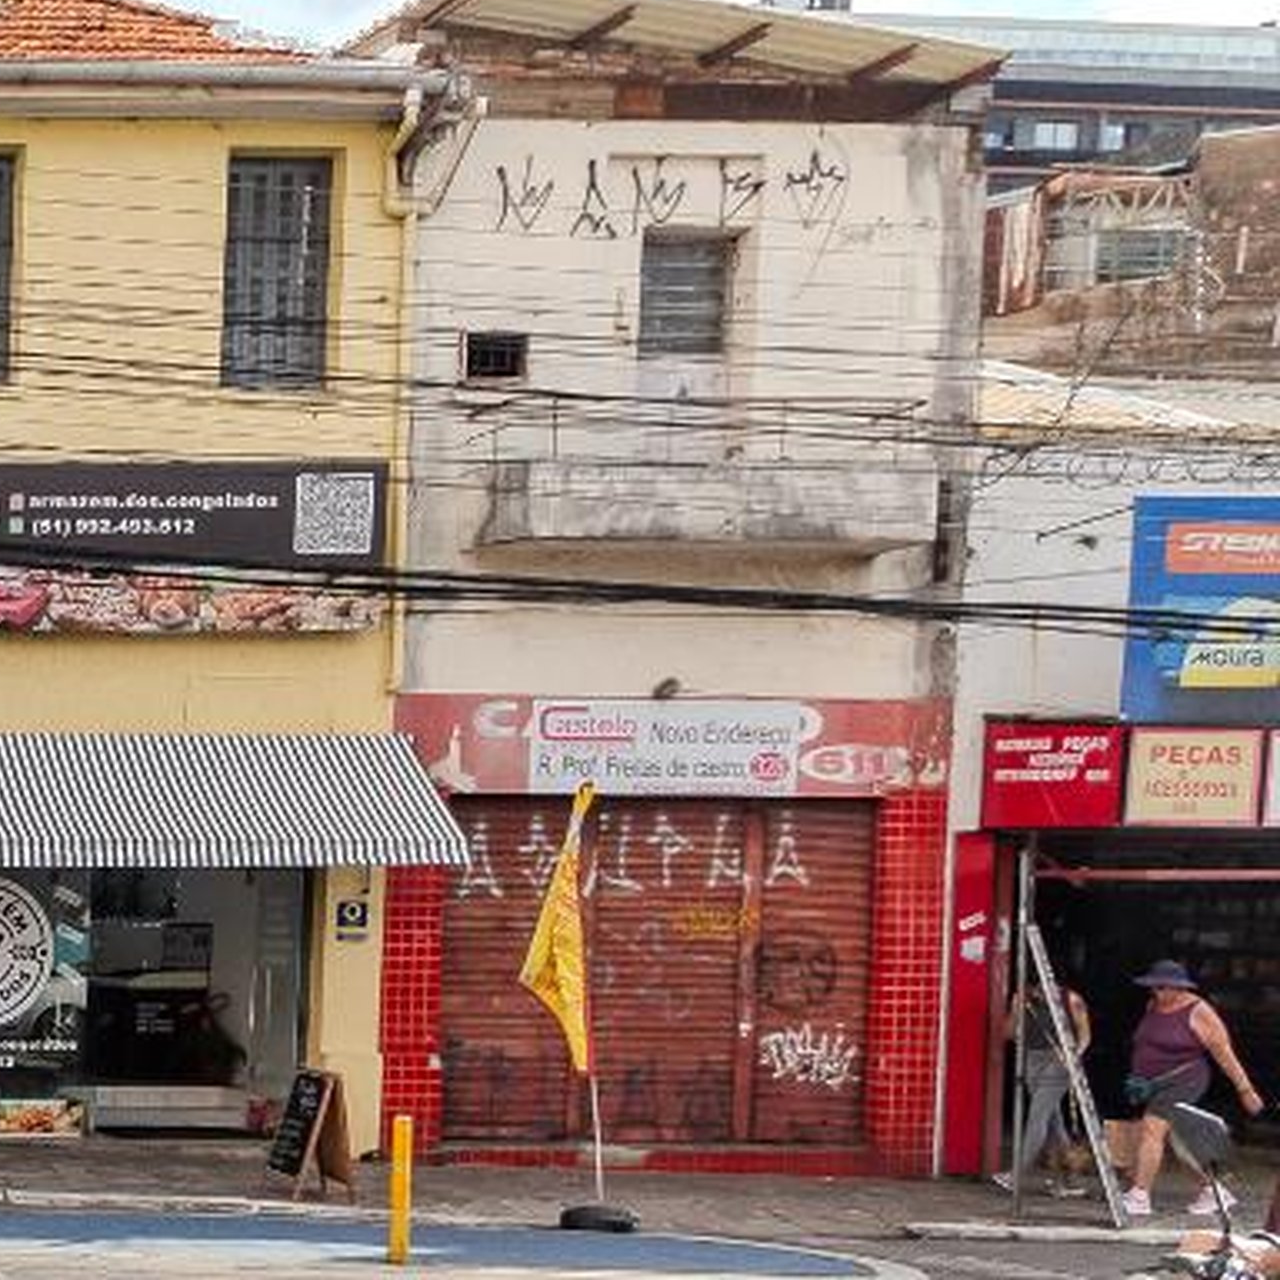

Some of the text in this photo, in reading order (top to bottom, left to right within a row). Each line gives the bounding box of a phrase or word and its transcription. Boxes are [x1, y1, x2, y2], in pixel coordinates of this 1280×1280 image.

[650, 720, 696, 744] Novo
[702, 722, 791, 750] Endereço
[665, 756, 689, 778] de
